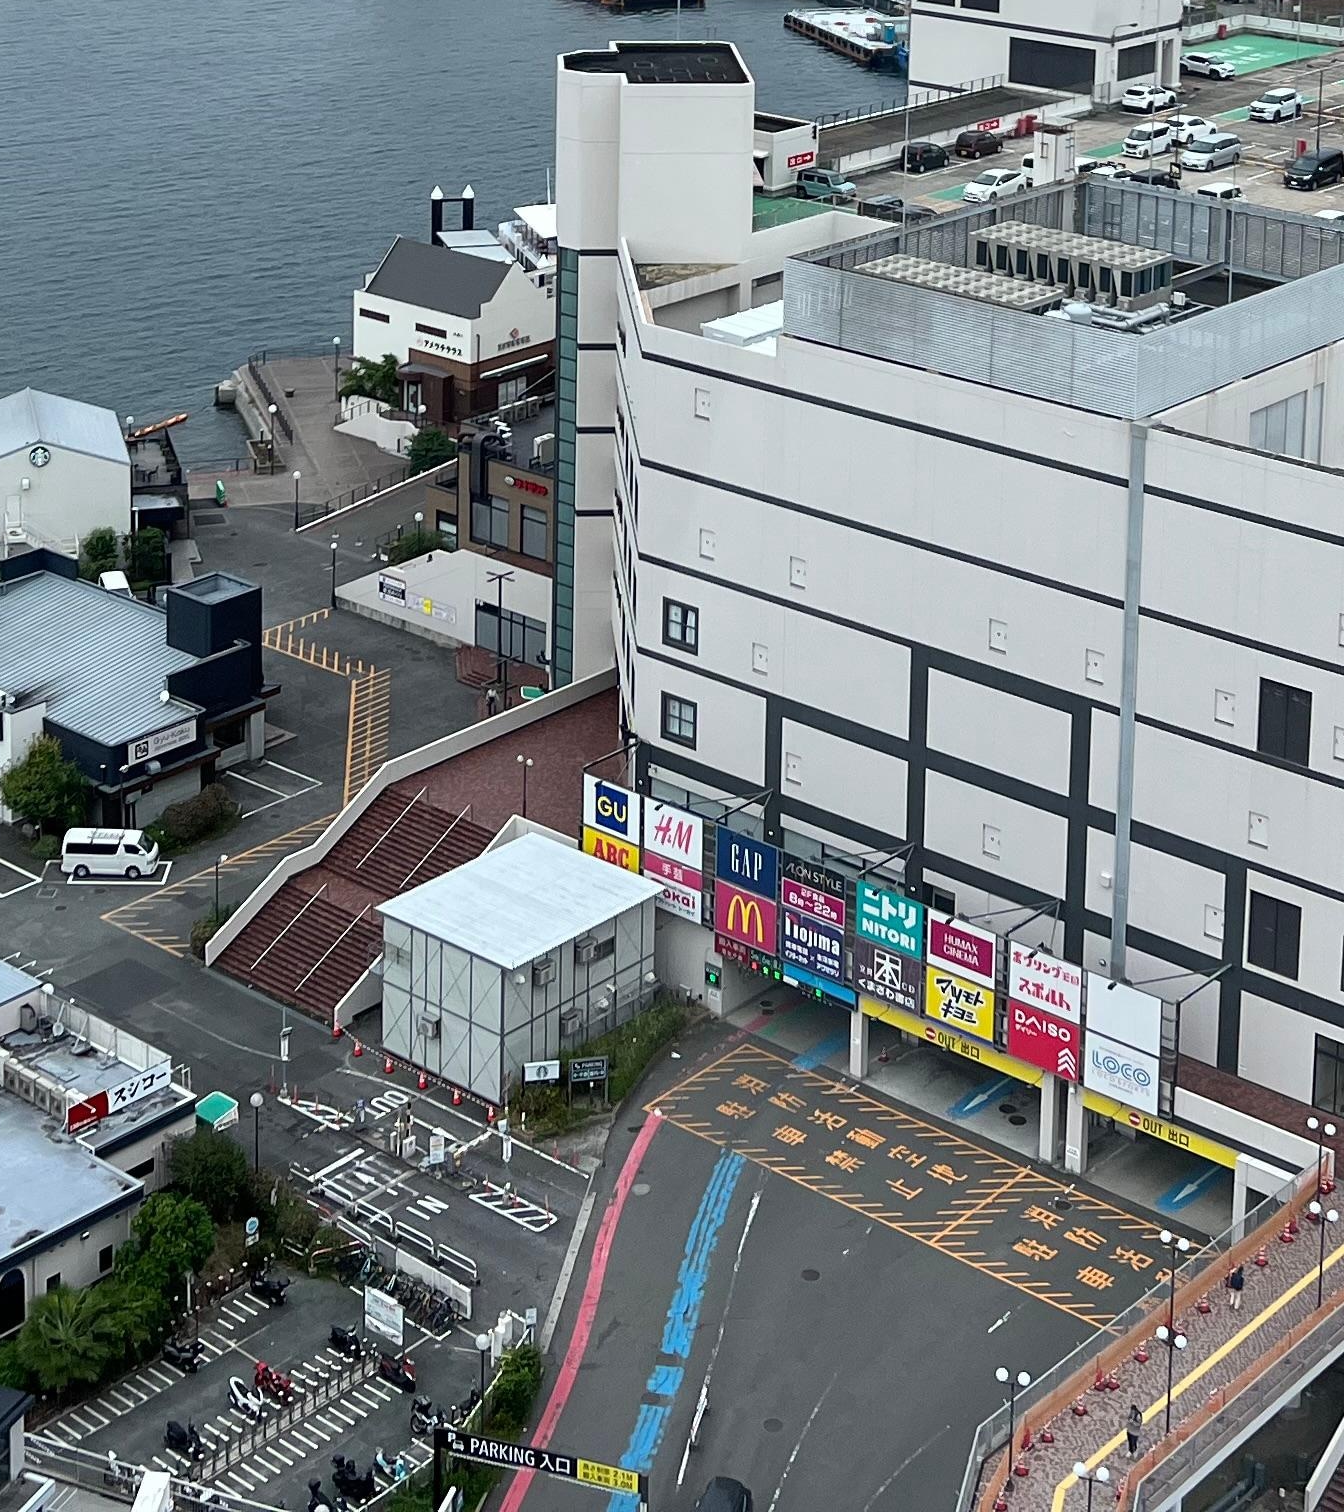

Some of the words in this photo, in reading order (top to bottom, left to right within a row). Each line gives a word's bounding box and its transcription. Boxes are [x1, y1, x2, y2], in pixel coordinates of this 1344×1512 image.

[597, 796, 627, 823] GU
[653, 813, 694, 855] H&M
[593, 838, 630, 869] ABC
[731, 843, 763, 881] GAP
[813, 872, 843, 892] STYLE
[662, 888, 696, 909] okai
[862, 887, 917, 929] ニトリ
[862, 917, 916, 952] NITORI
[944, 933, 979, 955] HUMAX
[943, 944, 979, 966] CINEMA
[935, 977, 984, 1006] マツモト
[1019, 977, 1071, 1011] スポルト
[941, 998, 977, 1024] キヨシ
[1014, 1008, 1072, 1042] DAISO
[938, 1031, 956, 1049] OUT
[961, 1042, 980, 1059] 出口
[1091, 1050, 1151, 1087] LOCO
[114, 1072, 167, 1105] スシロー
[1143, 1117, 1163, 1137] OUT
[1168, 1128, 1190, 1148] 出口
[406, 1195, 450, 1221] IN
[470, 1437, 536, 1466] PARKING
[539, 1454, 571, 1475] 入口
